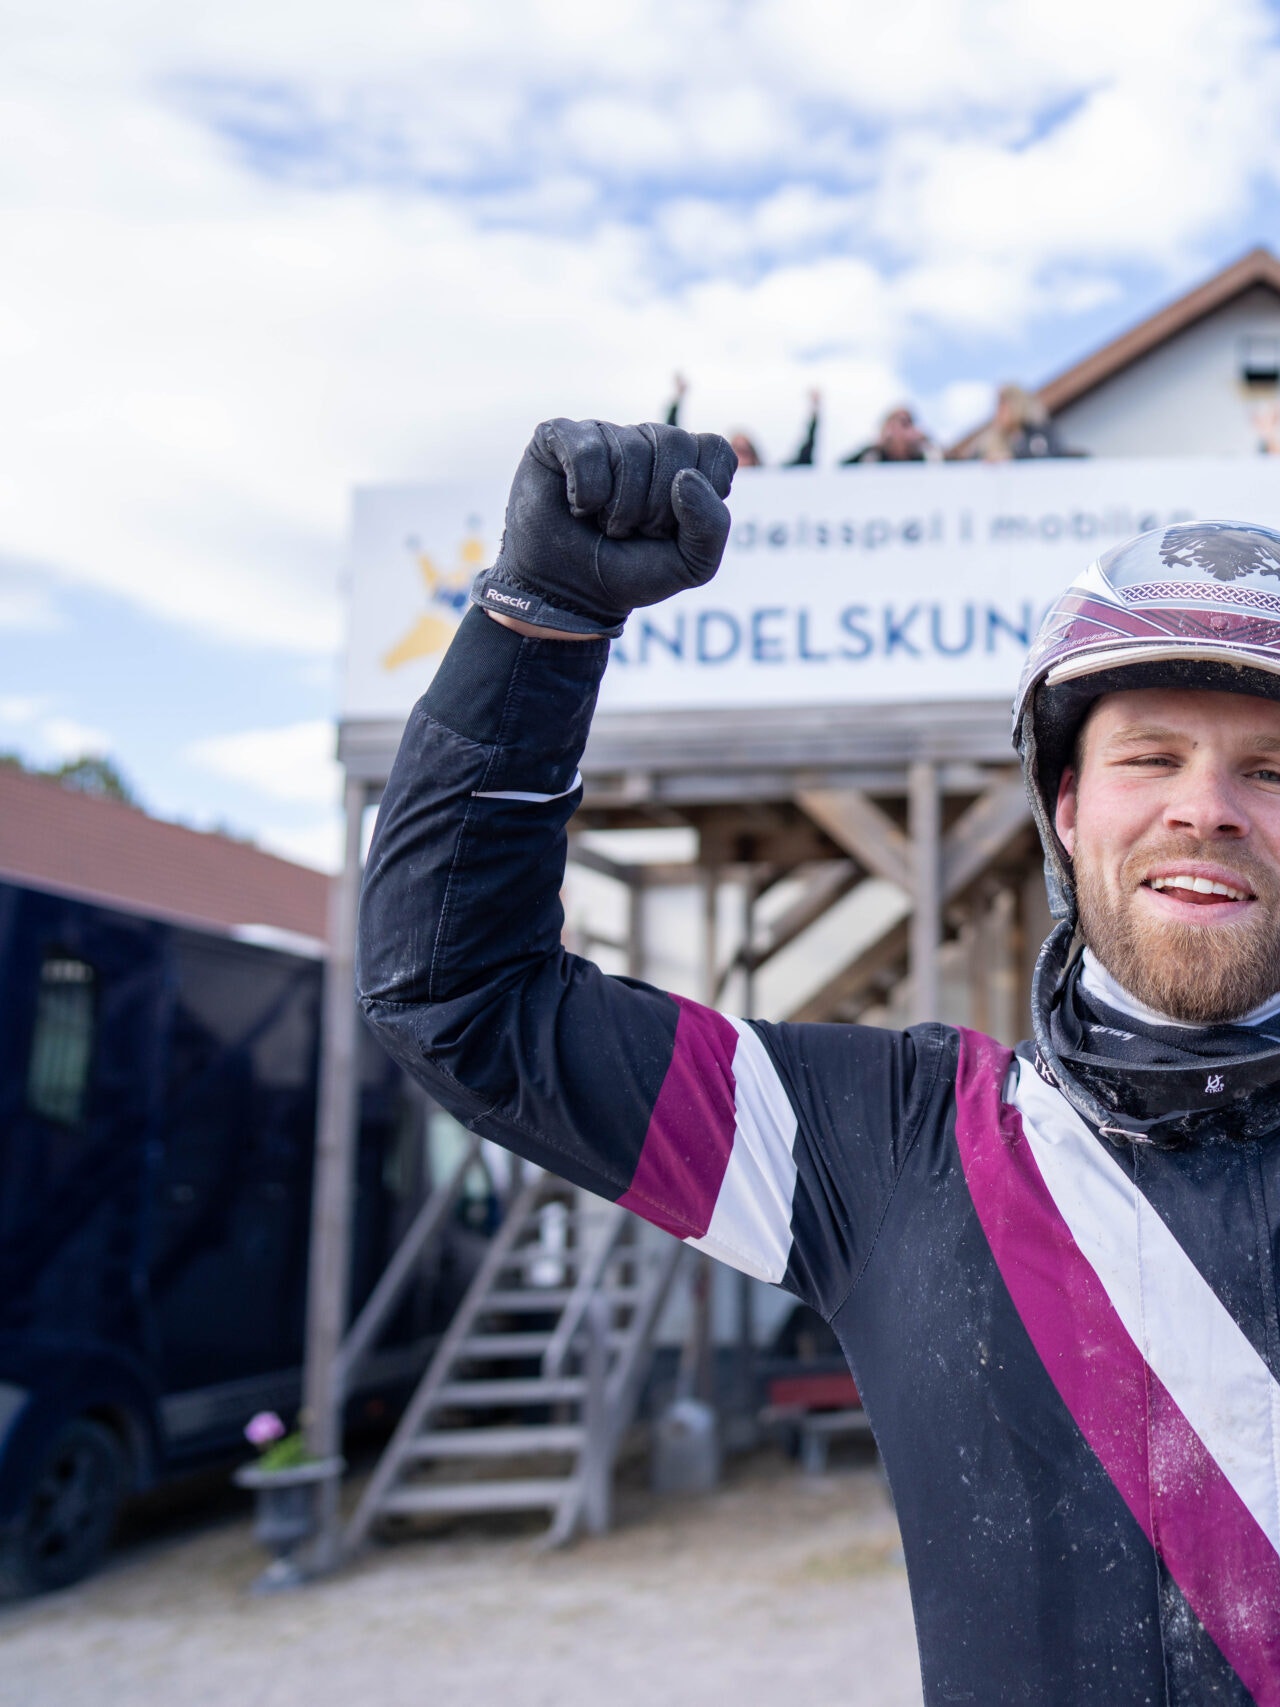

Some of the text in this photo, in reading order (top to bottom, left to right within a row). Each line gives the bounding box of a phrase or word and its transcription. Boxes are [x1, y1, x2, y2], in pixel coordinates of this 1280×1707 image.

[733, 510, 943, 554] delsspel
[486, 588, 531, 611] Roeckl
[611, 602, 1056, 665] NDELSKUN
